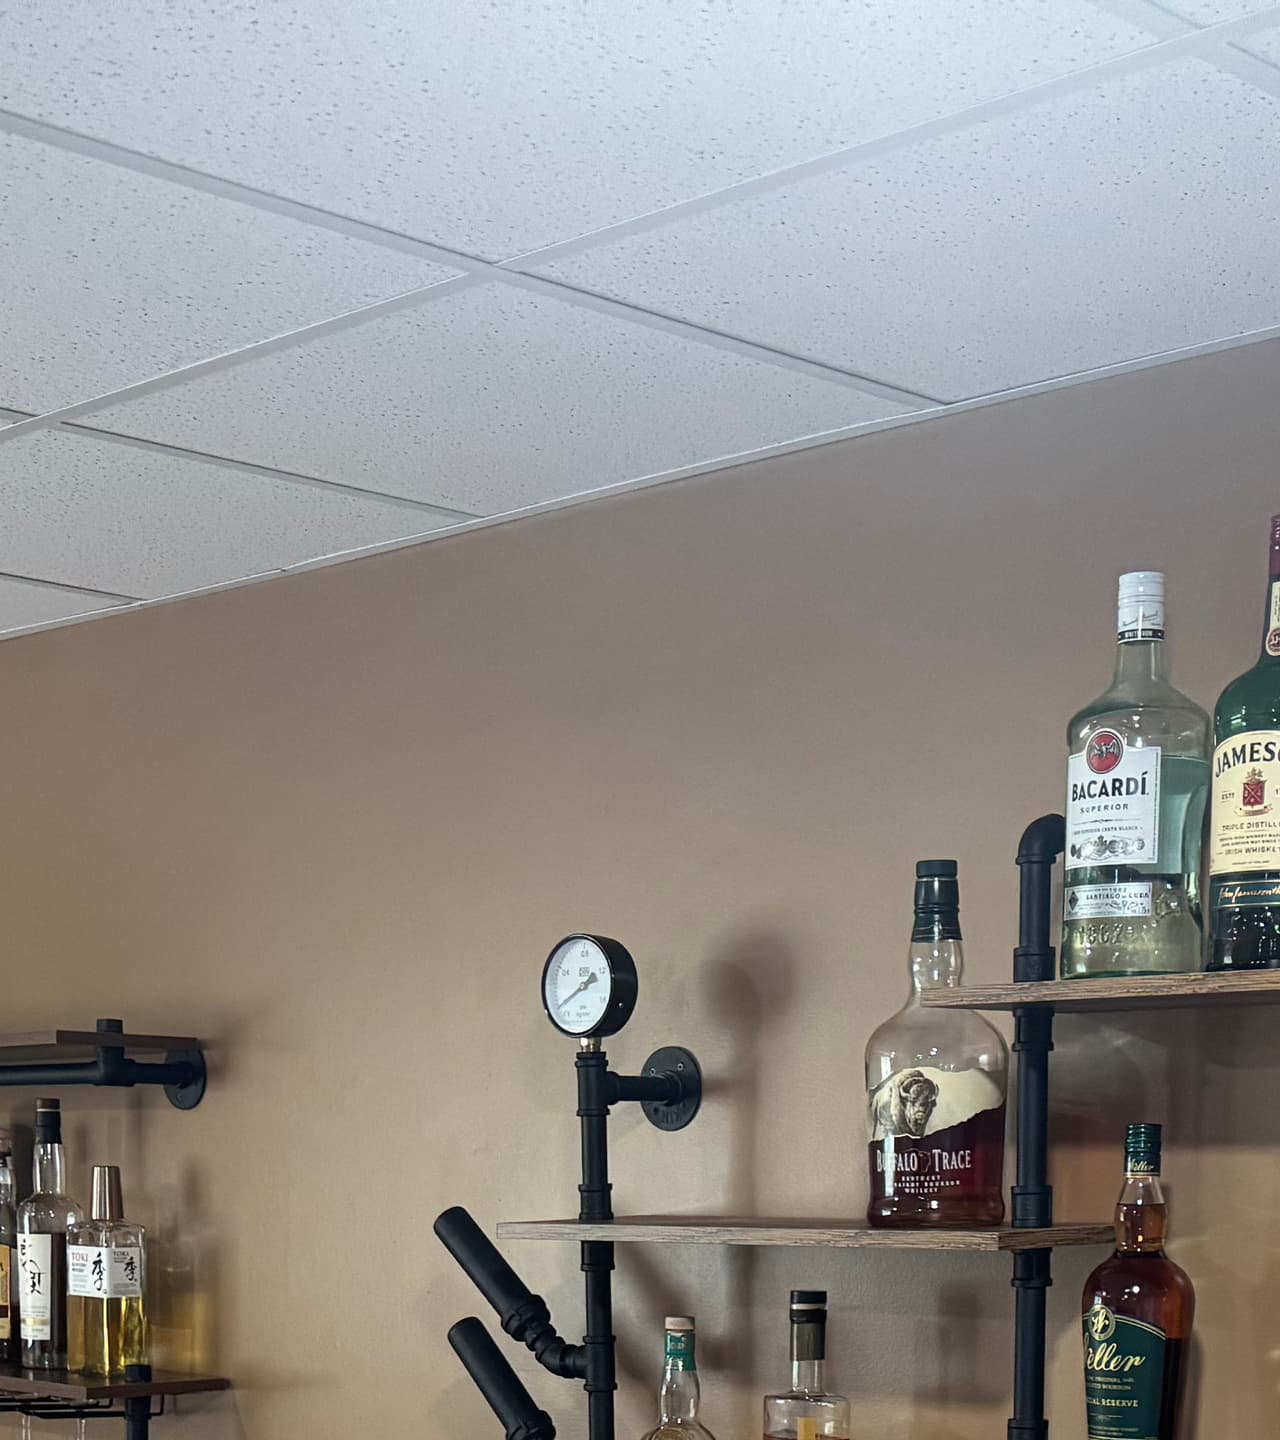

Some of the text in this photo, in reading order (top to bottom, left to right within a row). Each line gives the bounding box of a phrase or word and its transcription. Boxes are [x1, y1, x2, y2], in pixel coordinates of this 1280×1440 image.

[1071, 771, 1148, 802] BACARDÍ
[1080, 803, 1129, 814] SUPERIOR
[931, 1149, 972, 1172] TRACE
[72, 1252, 89, 1262] TOKI
[1101, 1398, 1139, 1408] RESERVE
